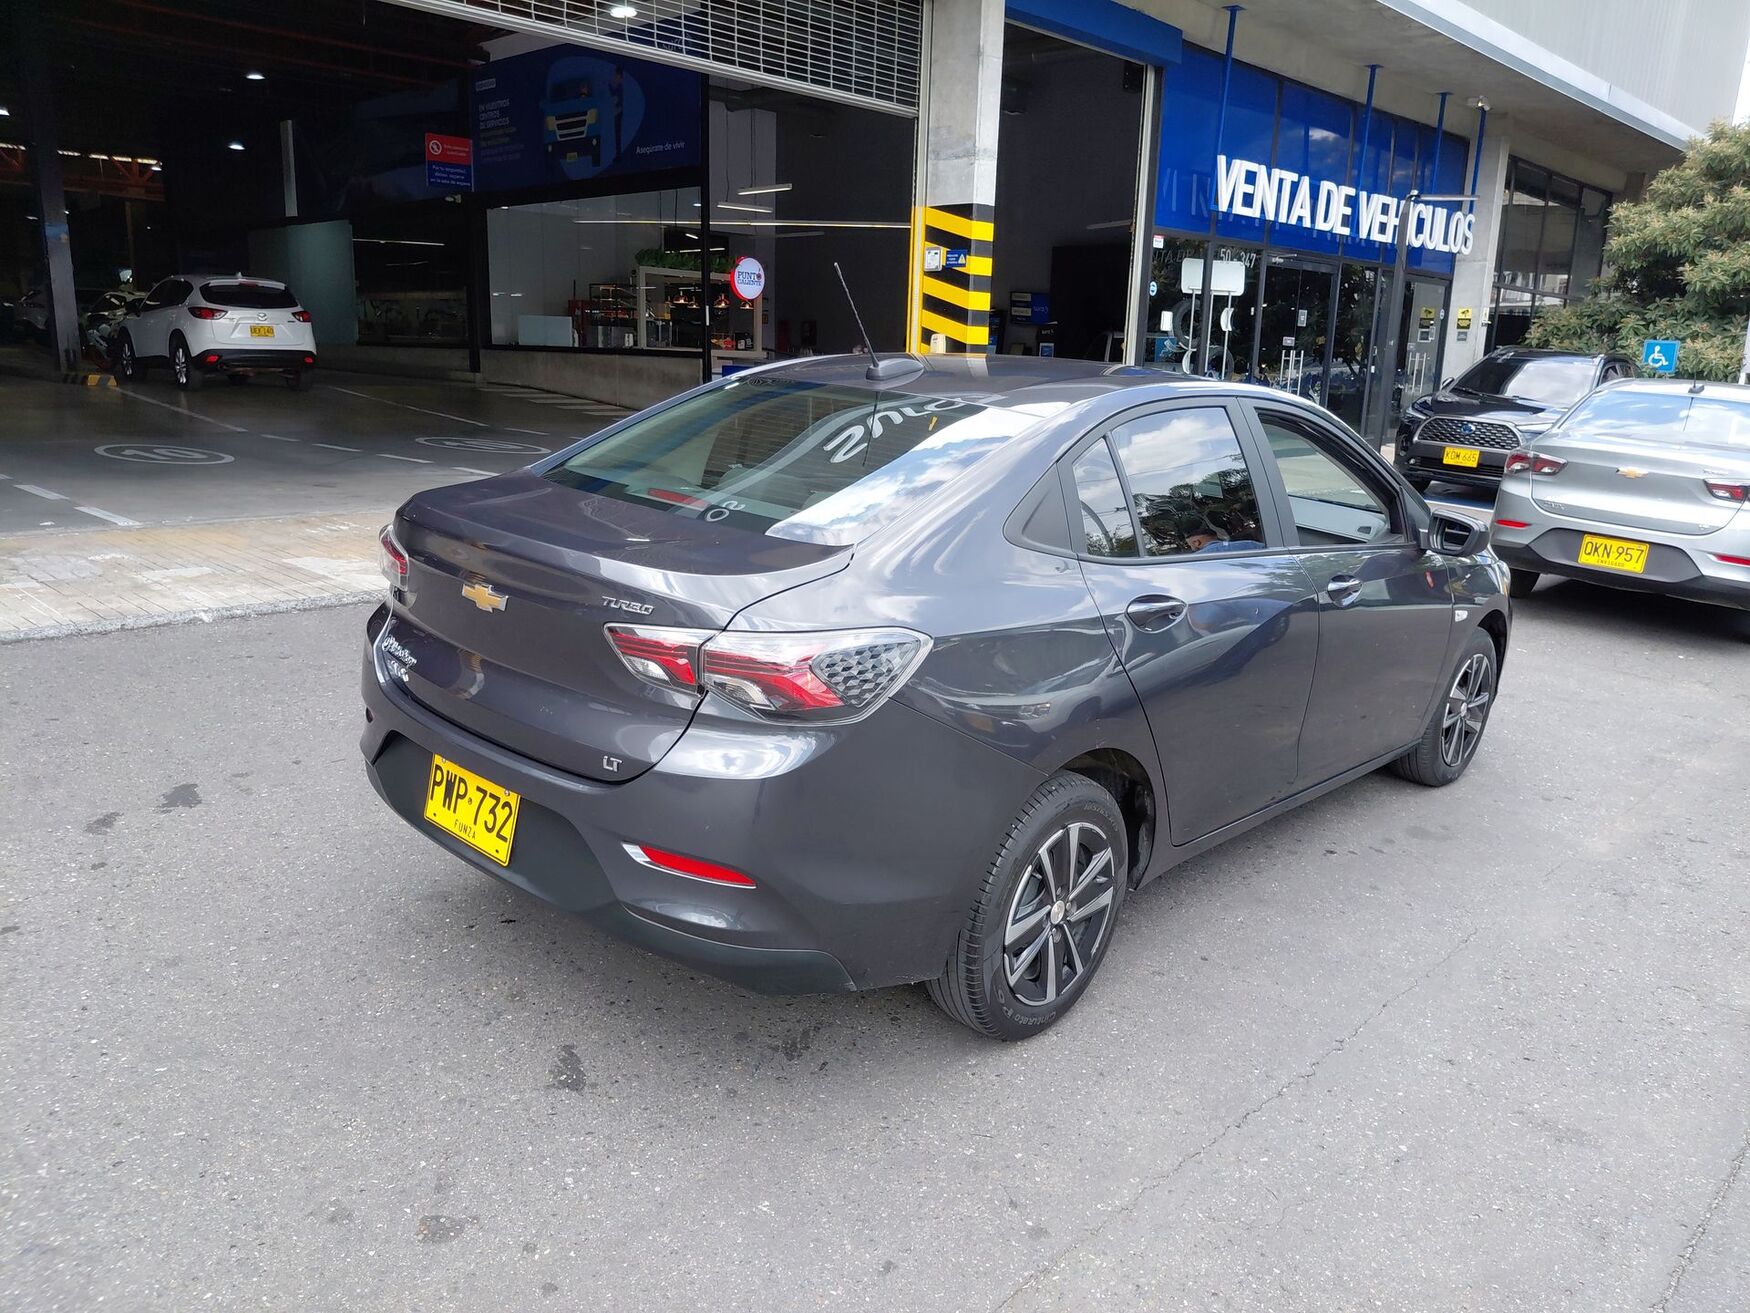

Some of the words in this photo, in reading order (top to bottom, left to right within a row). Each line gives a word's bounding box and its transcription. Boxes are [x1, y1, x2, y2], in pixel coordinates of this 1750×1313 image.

[1217, 155, 1312, 226] VENTA
[1313, 181, 1357, 236] DE
[737, 271, 762, 280] PUNTO
[1584, 541, 1613, 559] QKN
[1615, 545, 1644, 564] 957
[602, 595, 655, 616] TURBO
[603, 755, 623, 773] LT
[430, 764, 470, 815] PWP
[474, 785, 513, 843] 732
[454, 817, 477, 840] FUNZA
